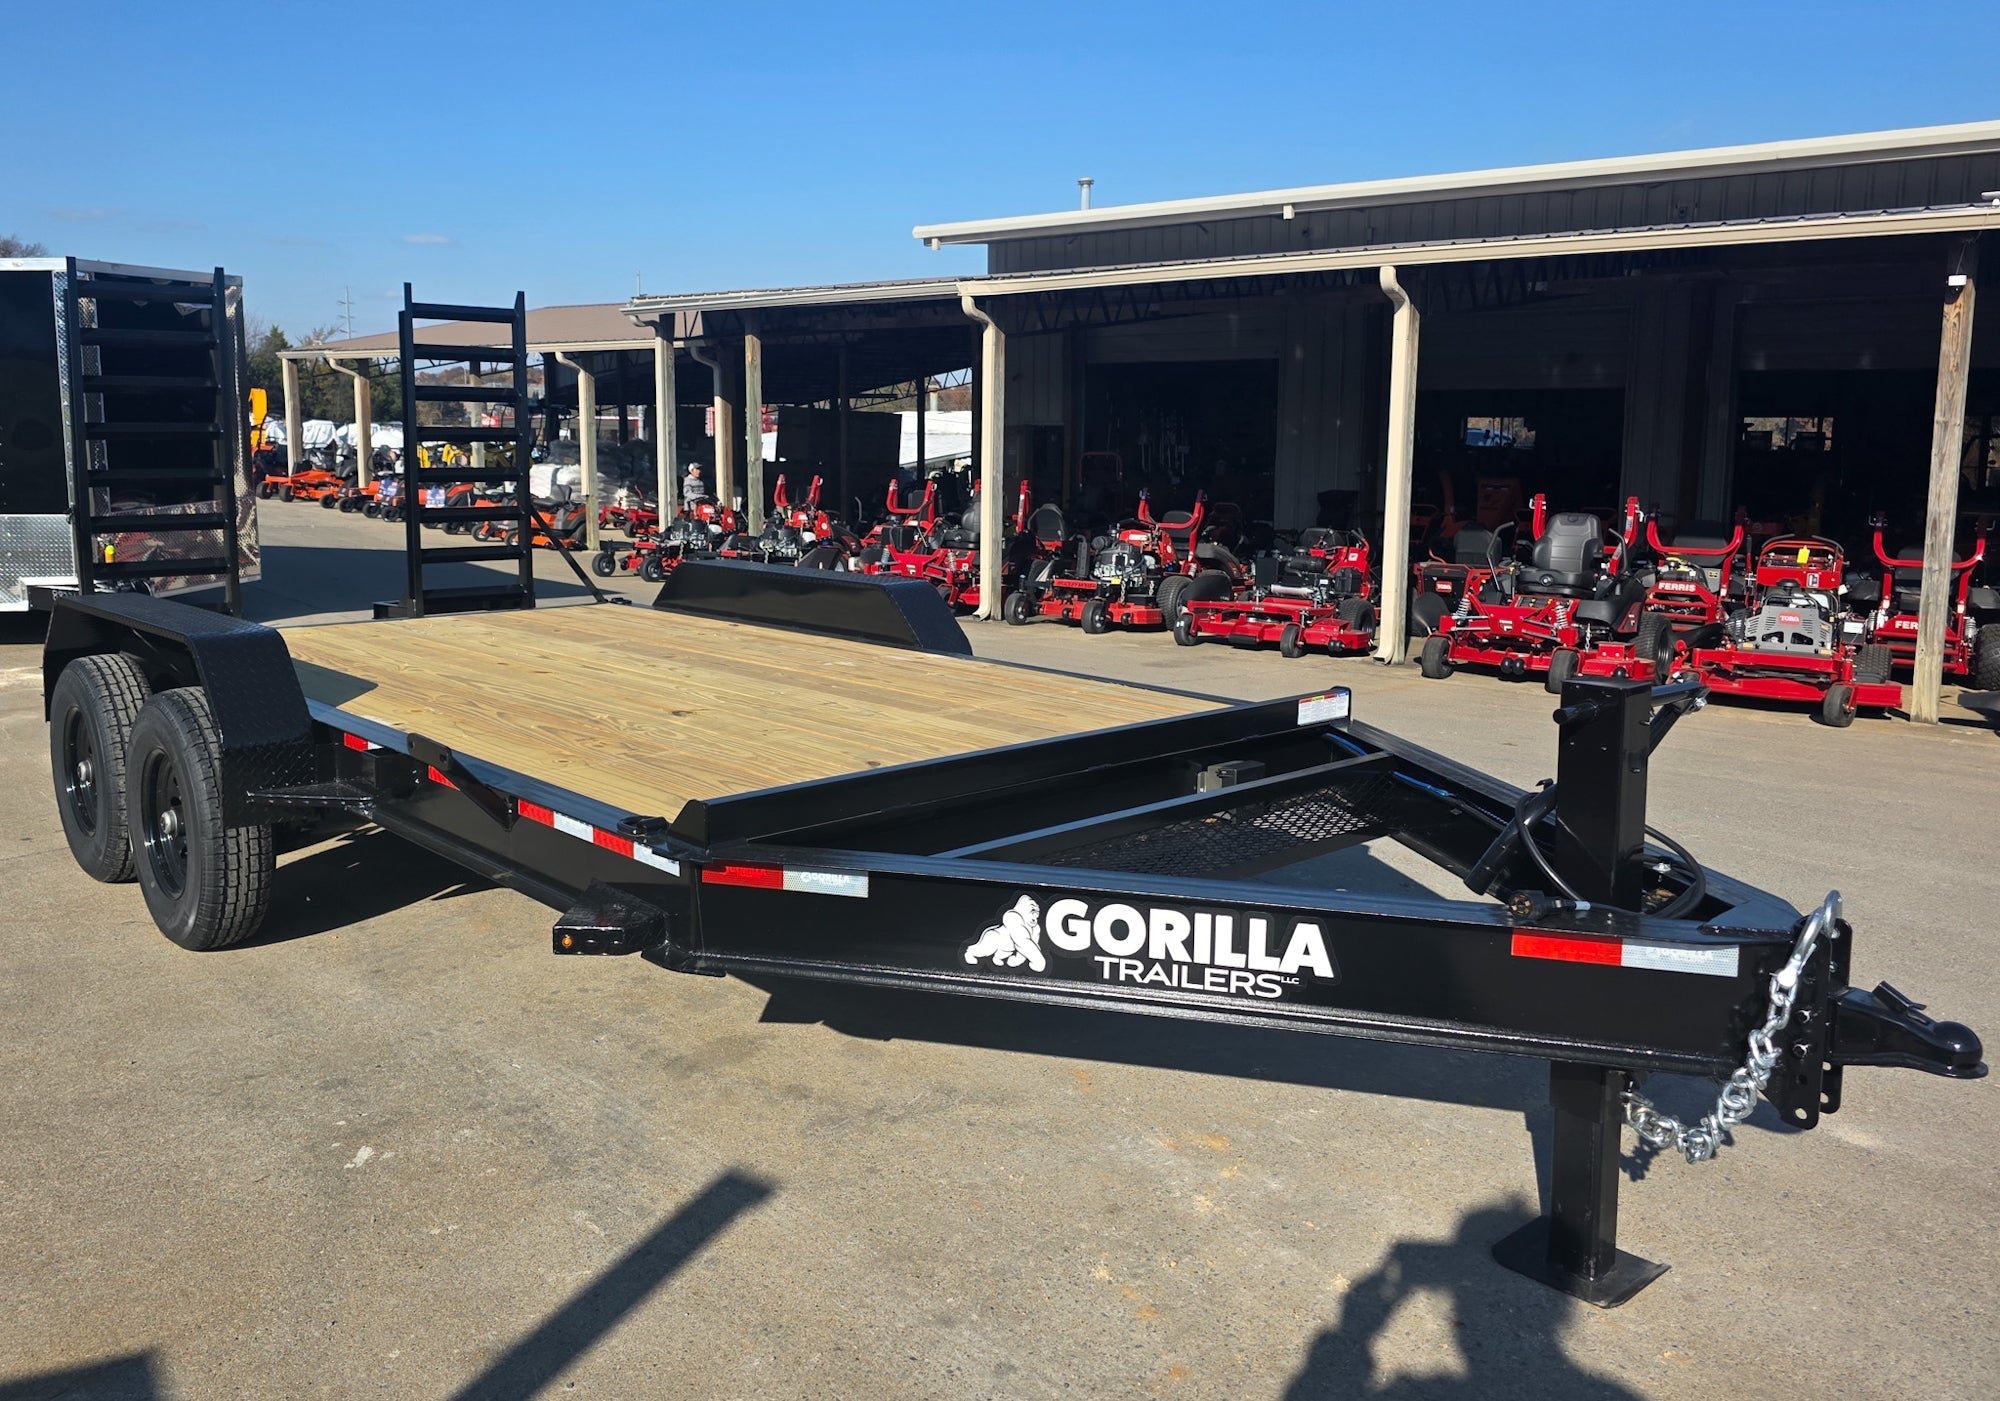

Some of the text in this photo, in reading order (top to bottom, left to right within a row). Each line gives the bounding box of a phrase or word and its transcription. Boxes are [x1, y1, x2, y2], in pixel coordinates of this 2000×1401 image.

[1658, 582, 1696, 592] FERRIS
[1895, 620, 1919, 630] FER
[1045, 898, 1334, 979] GORILLA
[1094, 955, 1300, 999] TRAILERS LLC
